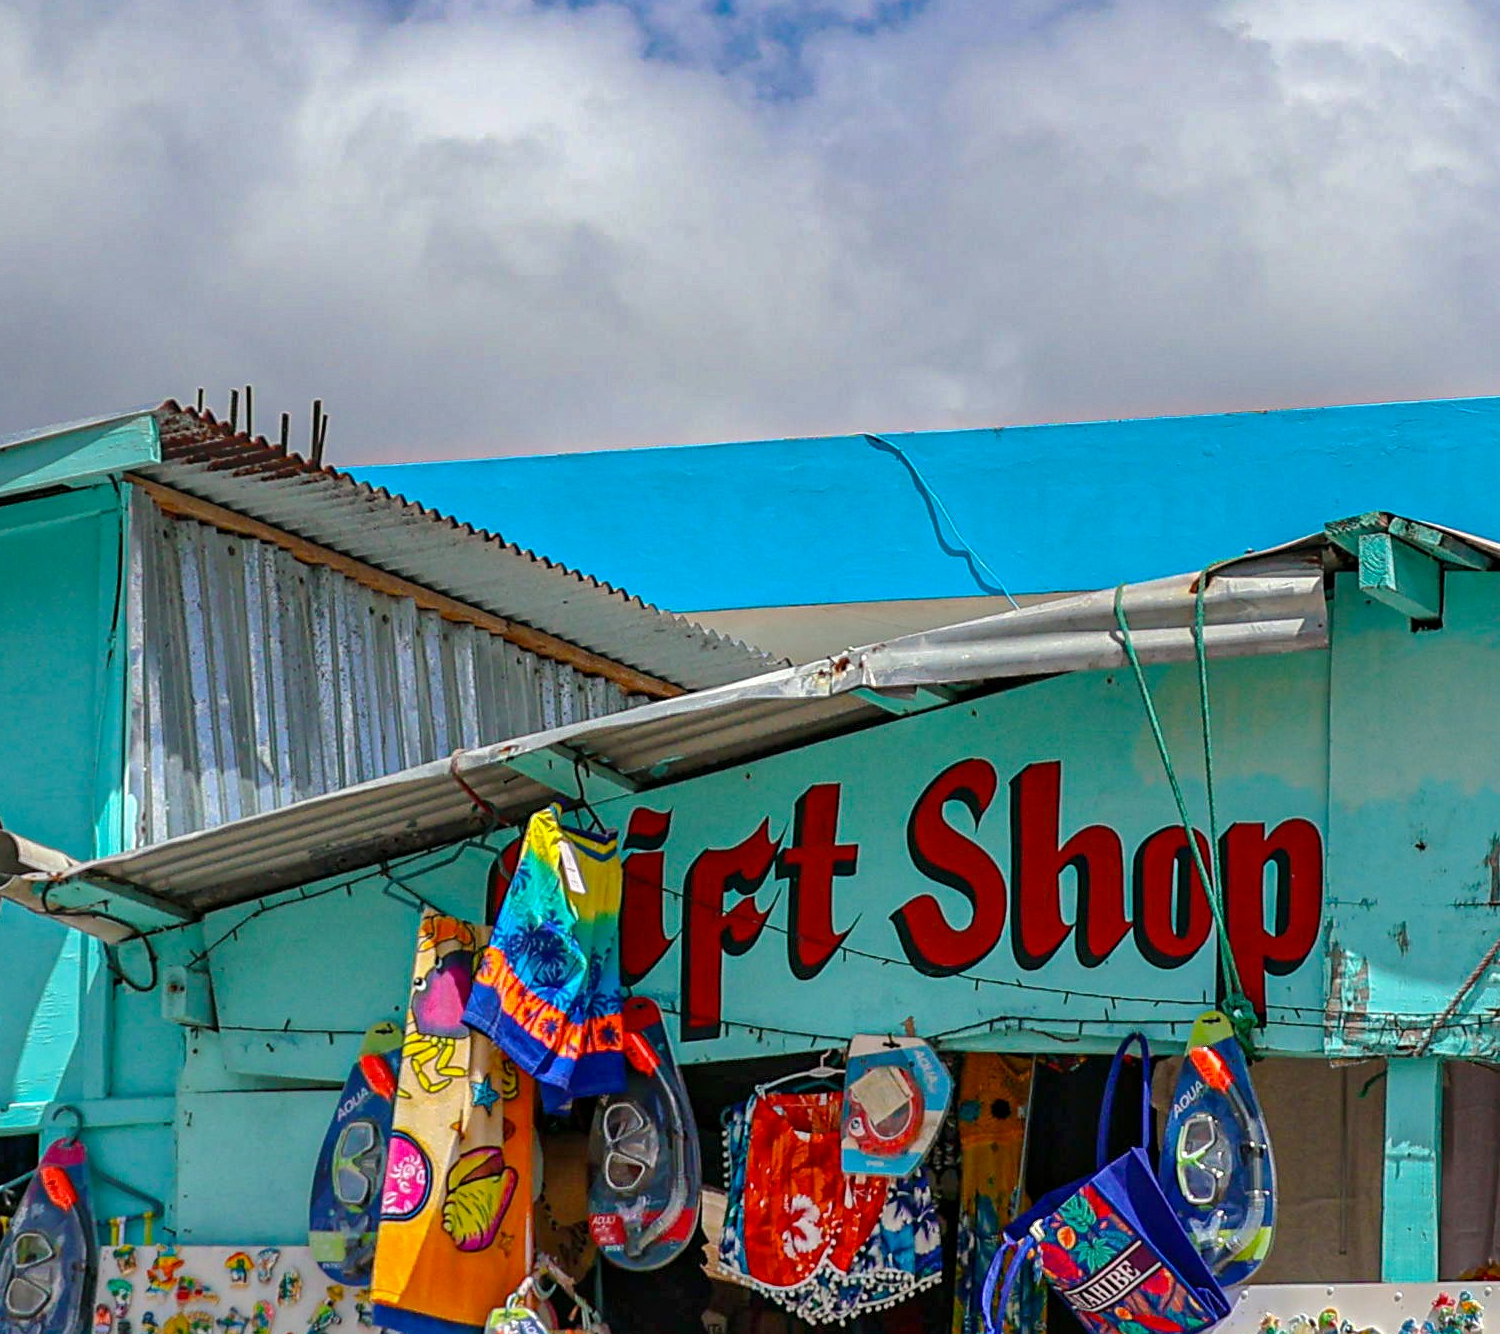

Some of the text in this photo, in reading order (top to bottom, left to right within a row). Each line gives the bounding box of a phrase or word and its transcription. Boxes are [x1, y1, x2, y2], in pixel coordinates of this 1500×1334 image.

[486, 757, 1325, 1042] ift Shop
[336, 1087, 369, 1121] AQUA
[1172, 1079, 1204, 1118] AQUA
